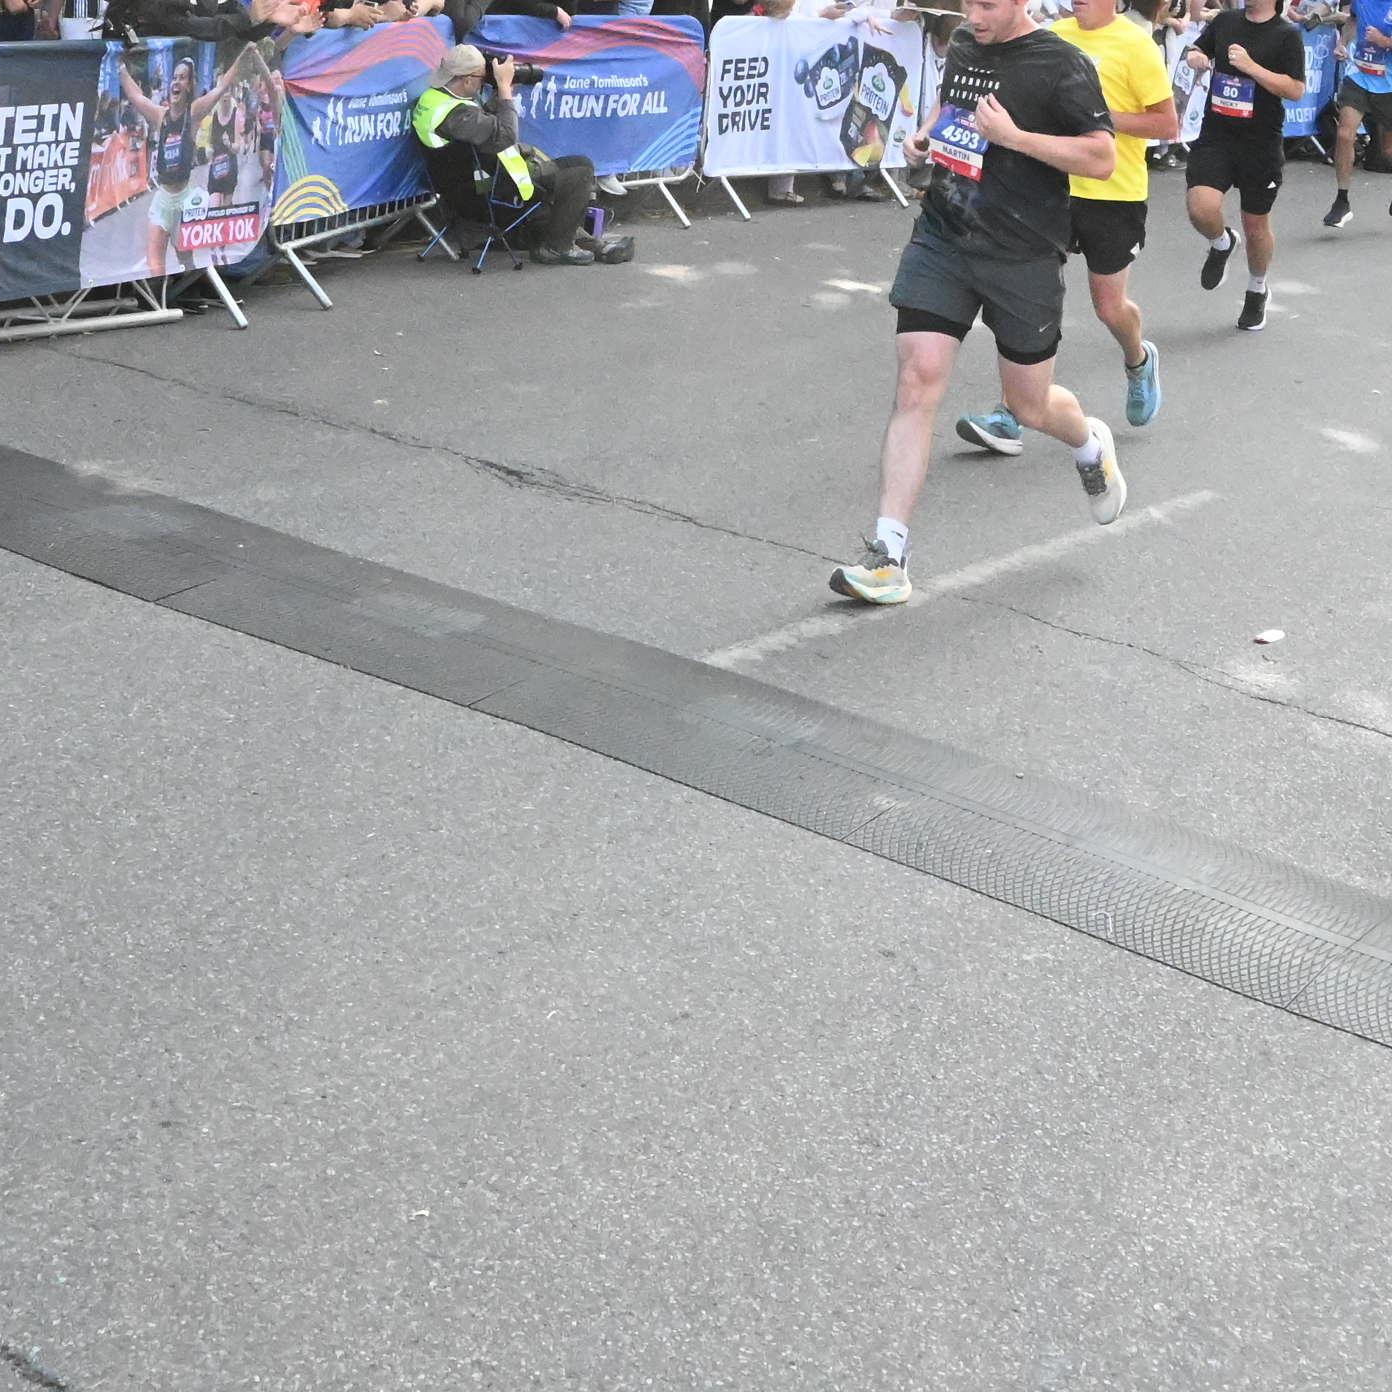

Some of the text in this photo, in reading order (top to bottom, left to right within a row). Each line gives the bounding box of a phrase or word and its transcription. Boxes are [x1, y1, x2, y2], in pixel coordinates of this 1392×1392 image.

[564, 75, 590, 89] Jane
[720, 56, 769, 82] FEED
[558, 91, 668, 119] RUN FOR ALL
[718, 83, 770, 109] YOUR
[861, 83, 889, 115] PROTEIN
[1222, 86, 1238, 98] 80
[344, 116, 374, 144] RUN
[376, 111, 401, 140] FOR
[717, 108, 772, 135] DRIVE
[941, 124, 980, 150] 4593
[15, 141, 80, 170] MAKE
[3, 192, 72, 243] DO.
[181, 218, 256, 247] YORK 10K
